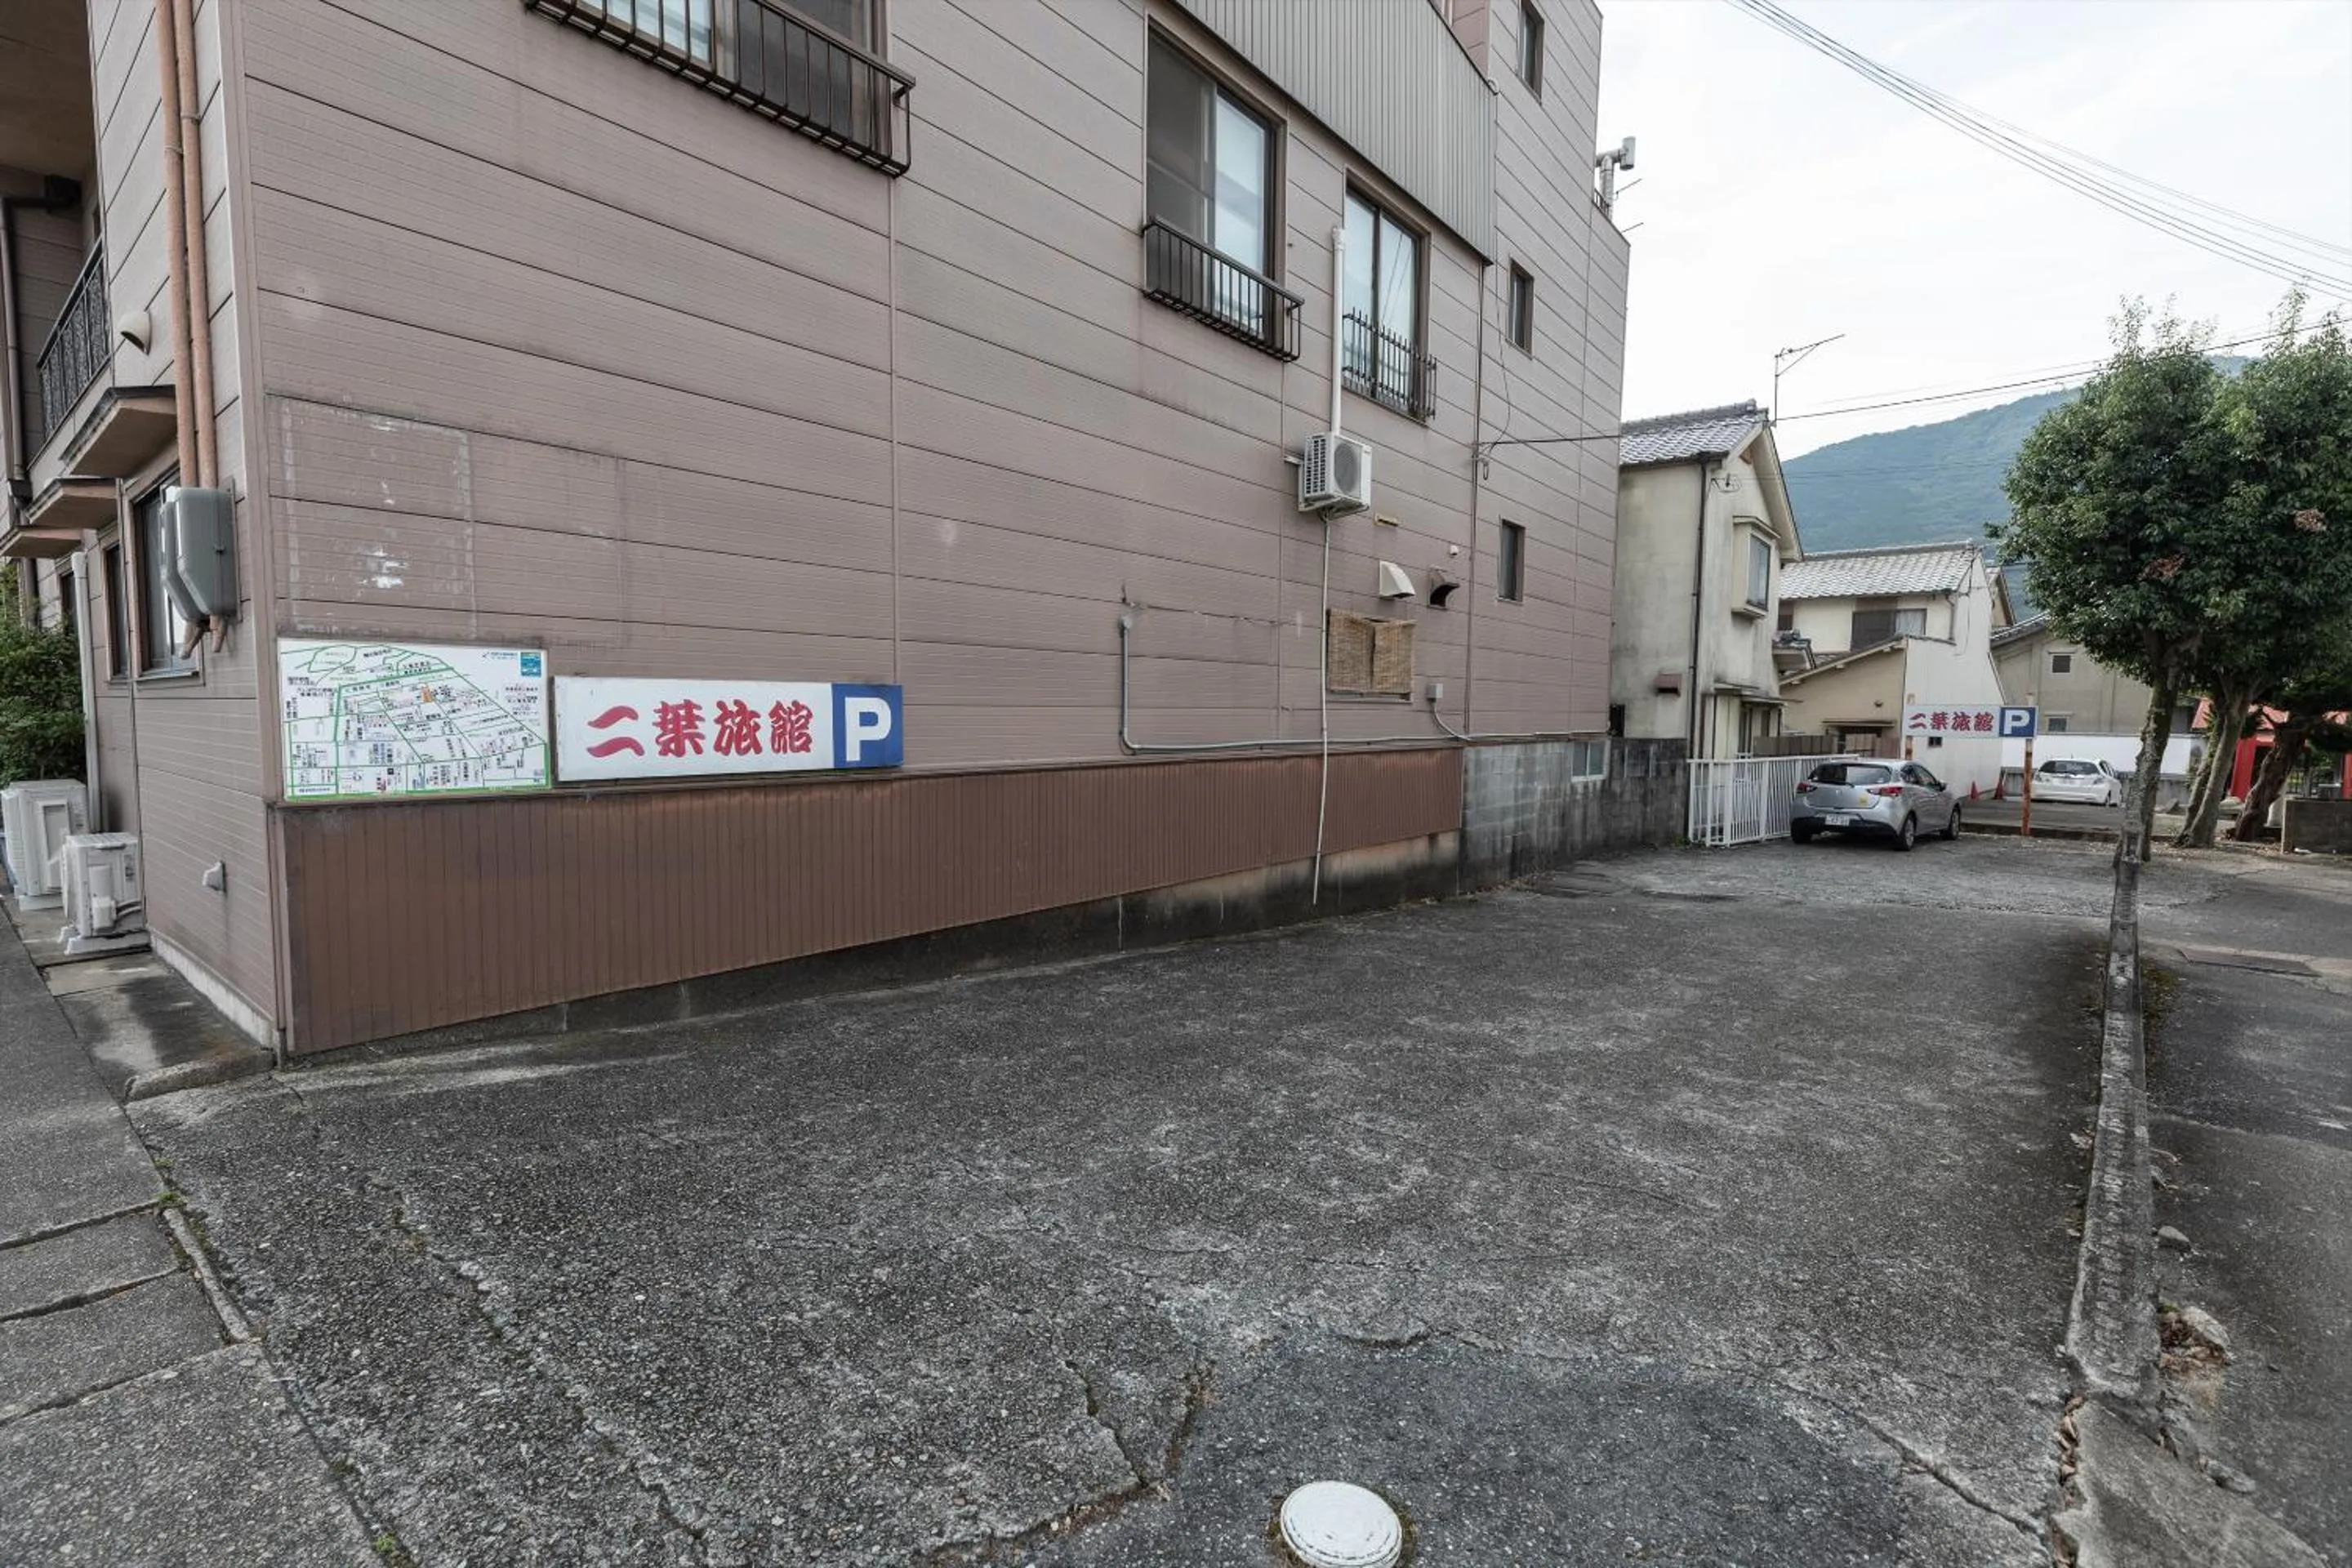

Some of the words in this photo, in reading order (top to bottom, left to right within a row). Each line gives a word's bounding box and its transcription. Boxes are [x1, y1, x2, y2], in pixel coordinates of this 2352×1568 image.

[587, 698, 814, 758] 二葉旅館
[844, 697, 892, 762] P
[1908, 711, 1995, 732] 二葉旅館
[2004, 709, 2030, 734] P
